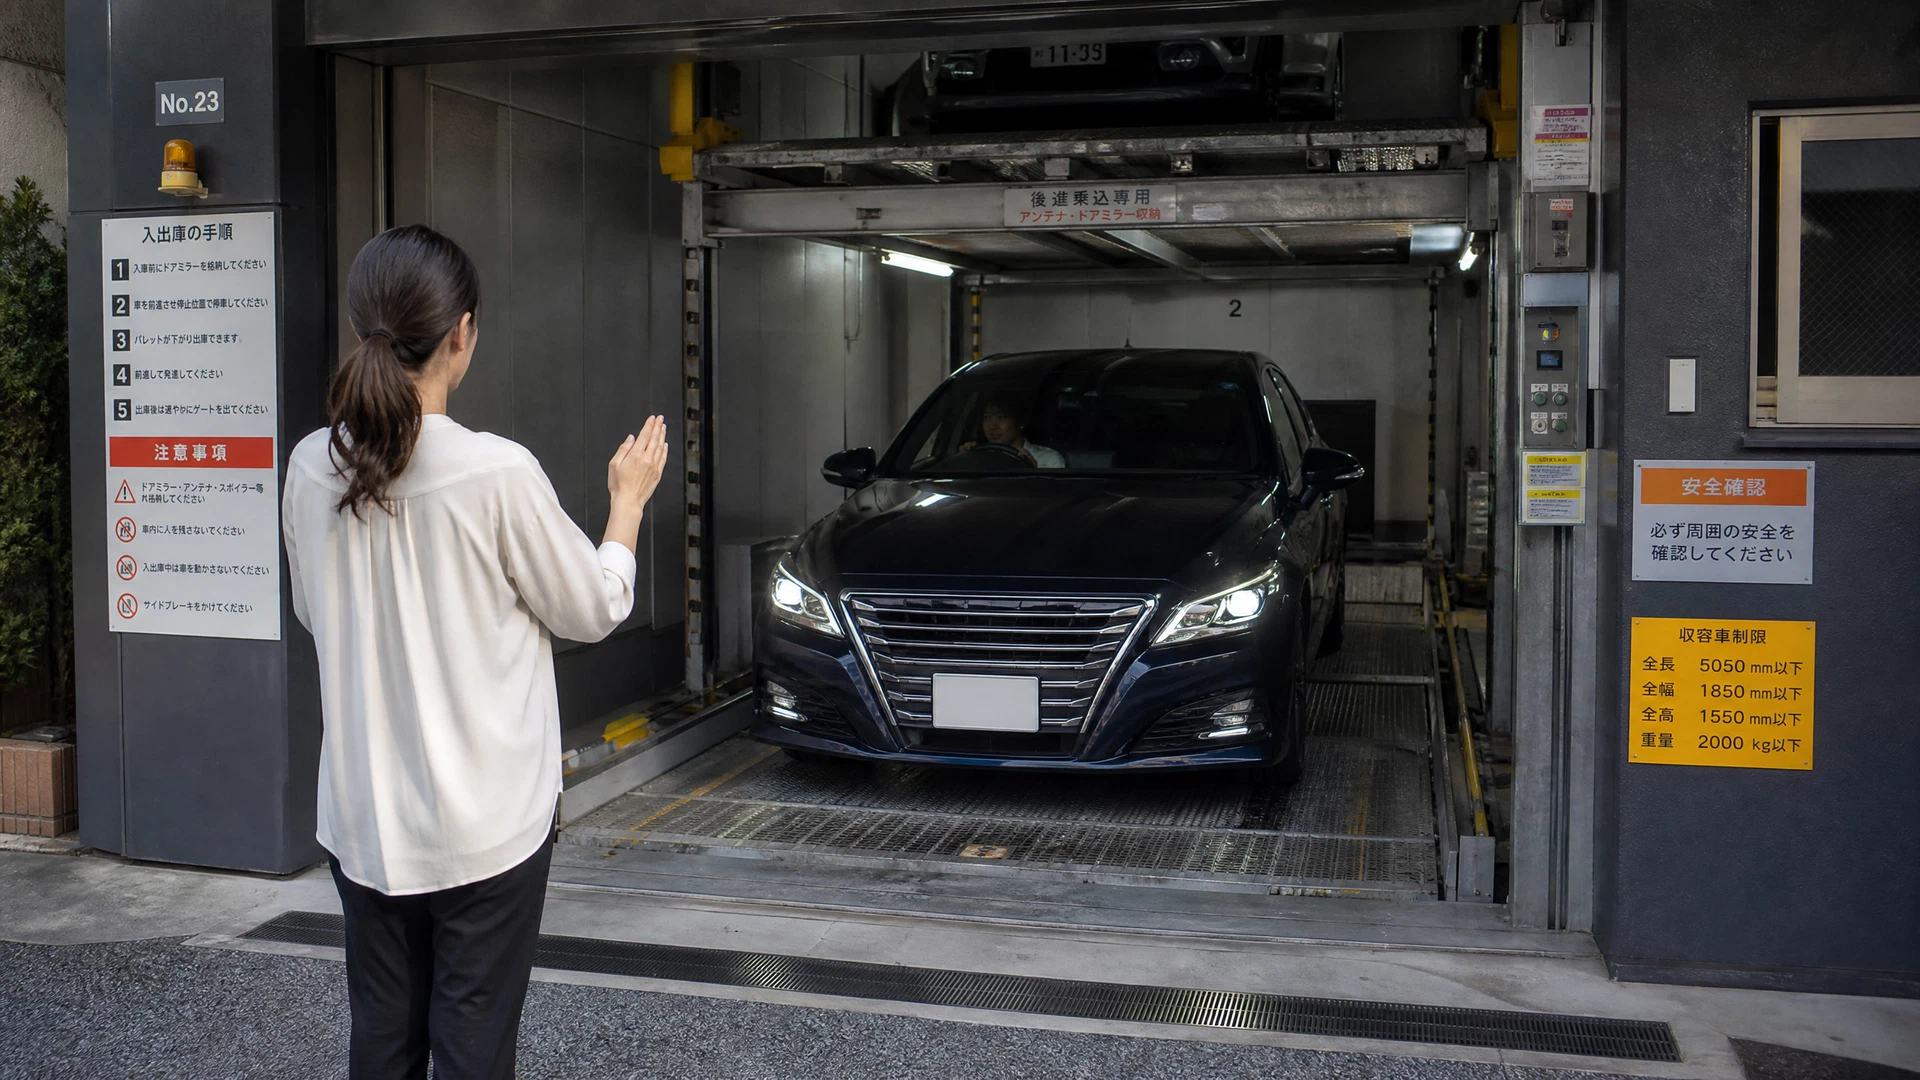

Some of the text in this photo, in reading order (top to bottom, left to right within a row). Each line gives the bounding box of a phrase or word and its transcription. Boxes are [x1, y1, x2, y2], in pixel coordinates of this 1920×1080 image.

[160, 90, 219, 115] No.23
[1031, 189, 1150, 208] 後進乗込専用
[1019, 208, 1162, 223] アンテナ・ドアミラー収納
[142, 223, 233, 243] 入出庫の手順
[116, 262, 124, 277] 1
[117, 298, 125, 313] 2
[1229, 300, 1241, 317] 2
[117, 332, 126, 348] 3
[117, 367, 127, 383] 4
[118, 403, 127, 418] 5
[155, 444, 226, 461] 注意事項
[1682, 477, 1765, 496] 安全確認
[142, 525, 245, 535] 車内に人を残さないでください
[1651, 523, 1794, 539] 必ず周囲の安全を
[1652, 545, 1792, 562] 確認してください
[144, 601, 252, 613] サイドブレーキをかけてください
[1679, 627, 1766, 644] 収容車制限
[1643, 656, 1803, 675] 全長 5050 mm以下
[1642, 682, 1802, 701] 全幅 1850 mm以下
[1642, 707, 1801, 726] 全高 1550 mm以下
[1641, 732, 1801, 753] 重量 2000 kg以下
